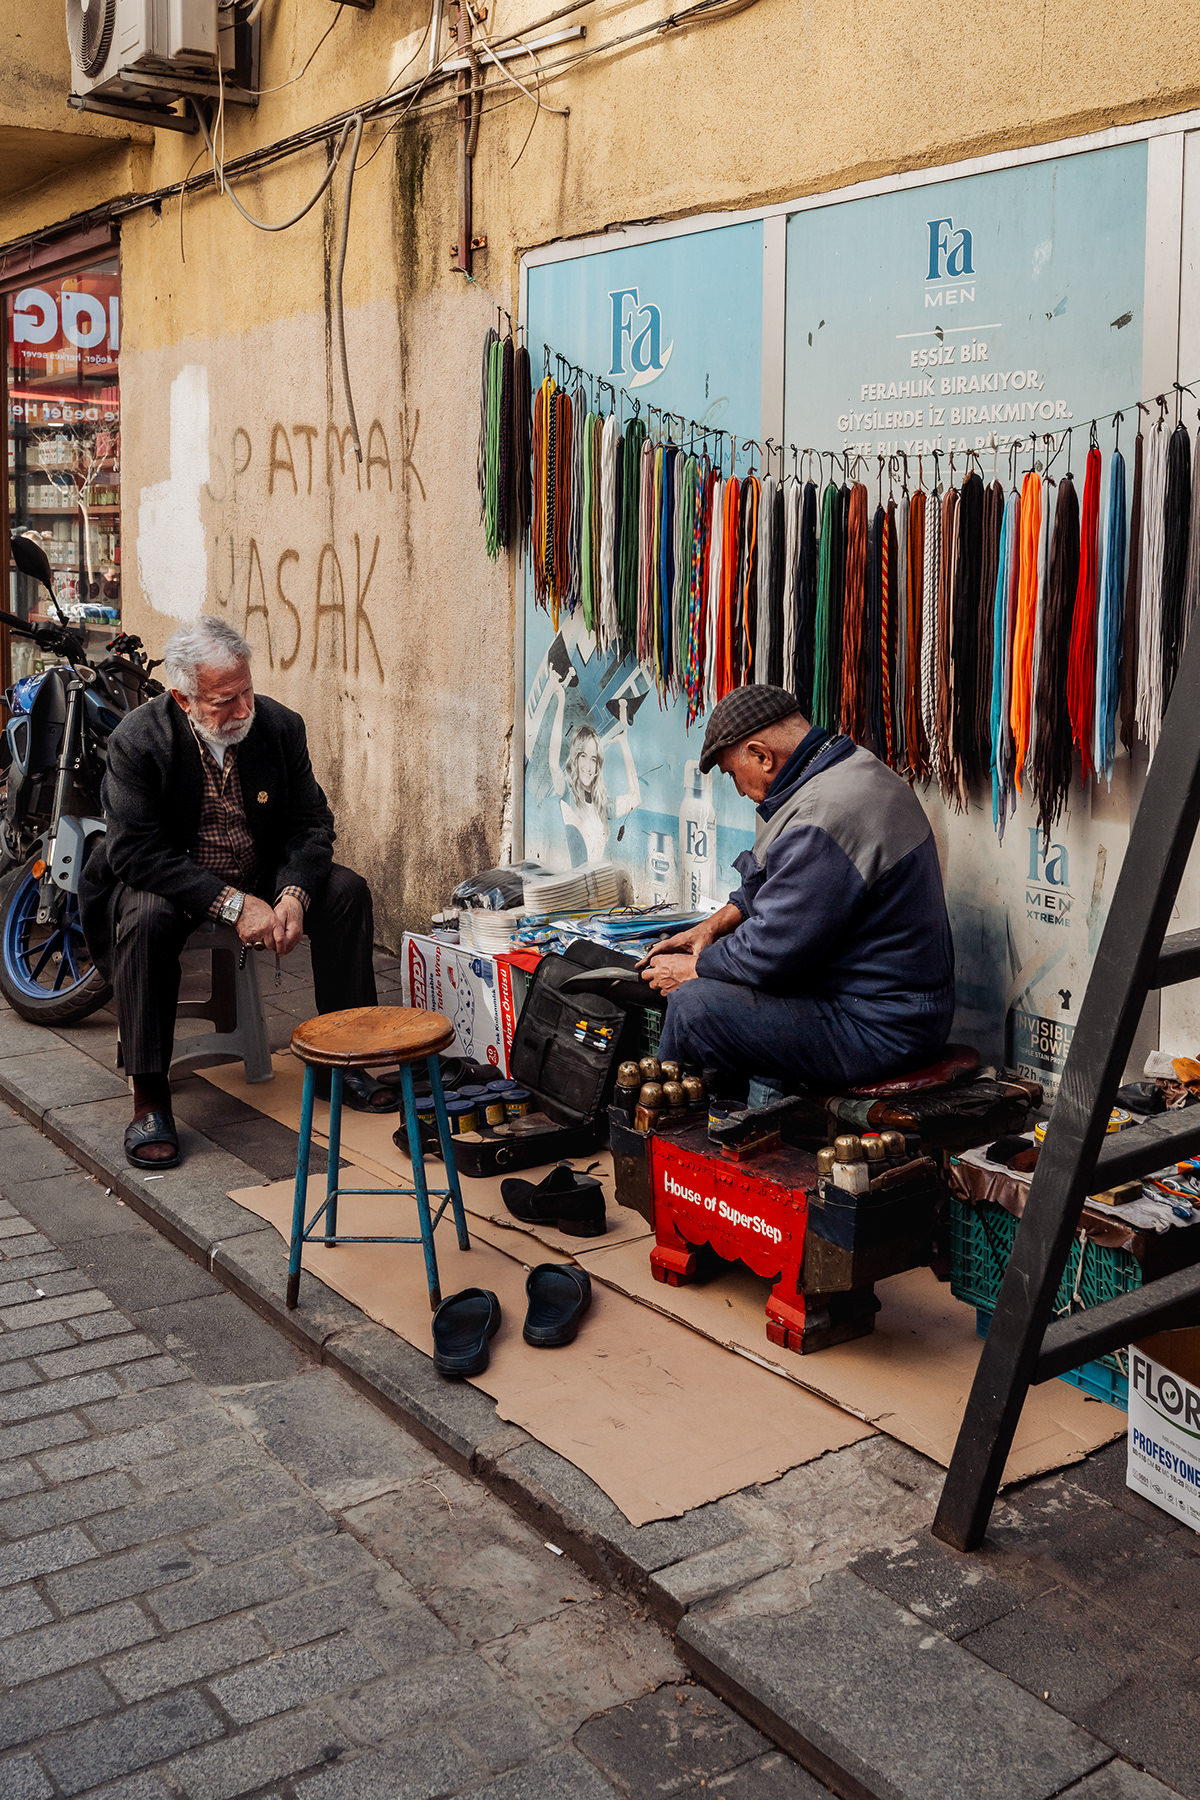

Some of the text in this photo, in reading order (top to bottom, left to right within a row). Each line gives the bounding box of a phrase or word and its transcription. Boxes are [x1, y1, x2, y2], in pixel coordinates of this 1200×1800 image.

[924, 216, 976, 281] Fa
[924, 287, 975, 308] MEN
[607, 286, 665, 377] Fa
[910, 338, 988, 372] EŞSİZ BİR
[860, 377, 935, 401] FERAHLIK
[837, 399, 1074, 432] GİYSİLERDE İZ BIRAKMIYOR.
[686, 820, 708, 858] Fa
[1026, 827, 1071, 888] Fa
[1025, 891, 1071, 913] MEN
[1026, 910, 1071, 928] XTREME
[434, 946, 444, 1011] Table Wrap
[500, 968, 511, 1012] Örtüsü
[487, 1048, 495, 1062] 20
[1018, 1064, 1037, 1081] 72h
[664, 1170, 782, 1244] House of SuperStep
